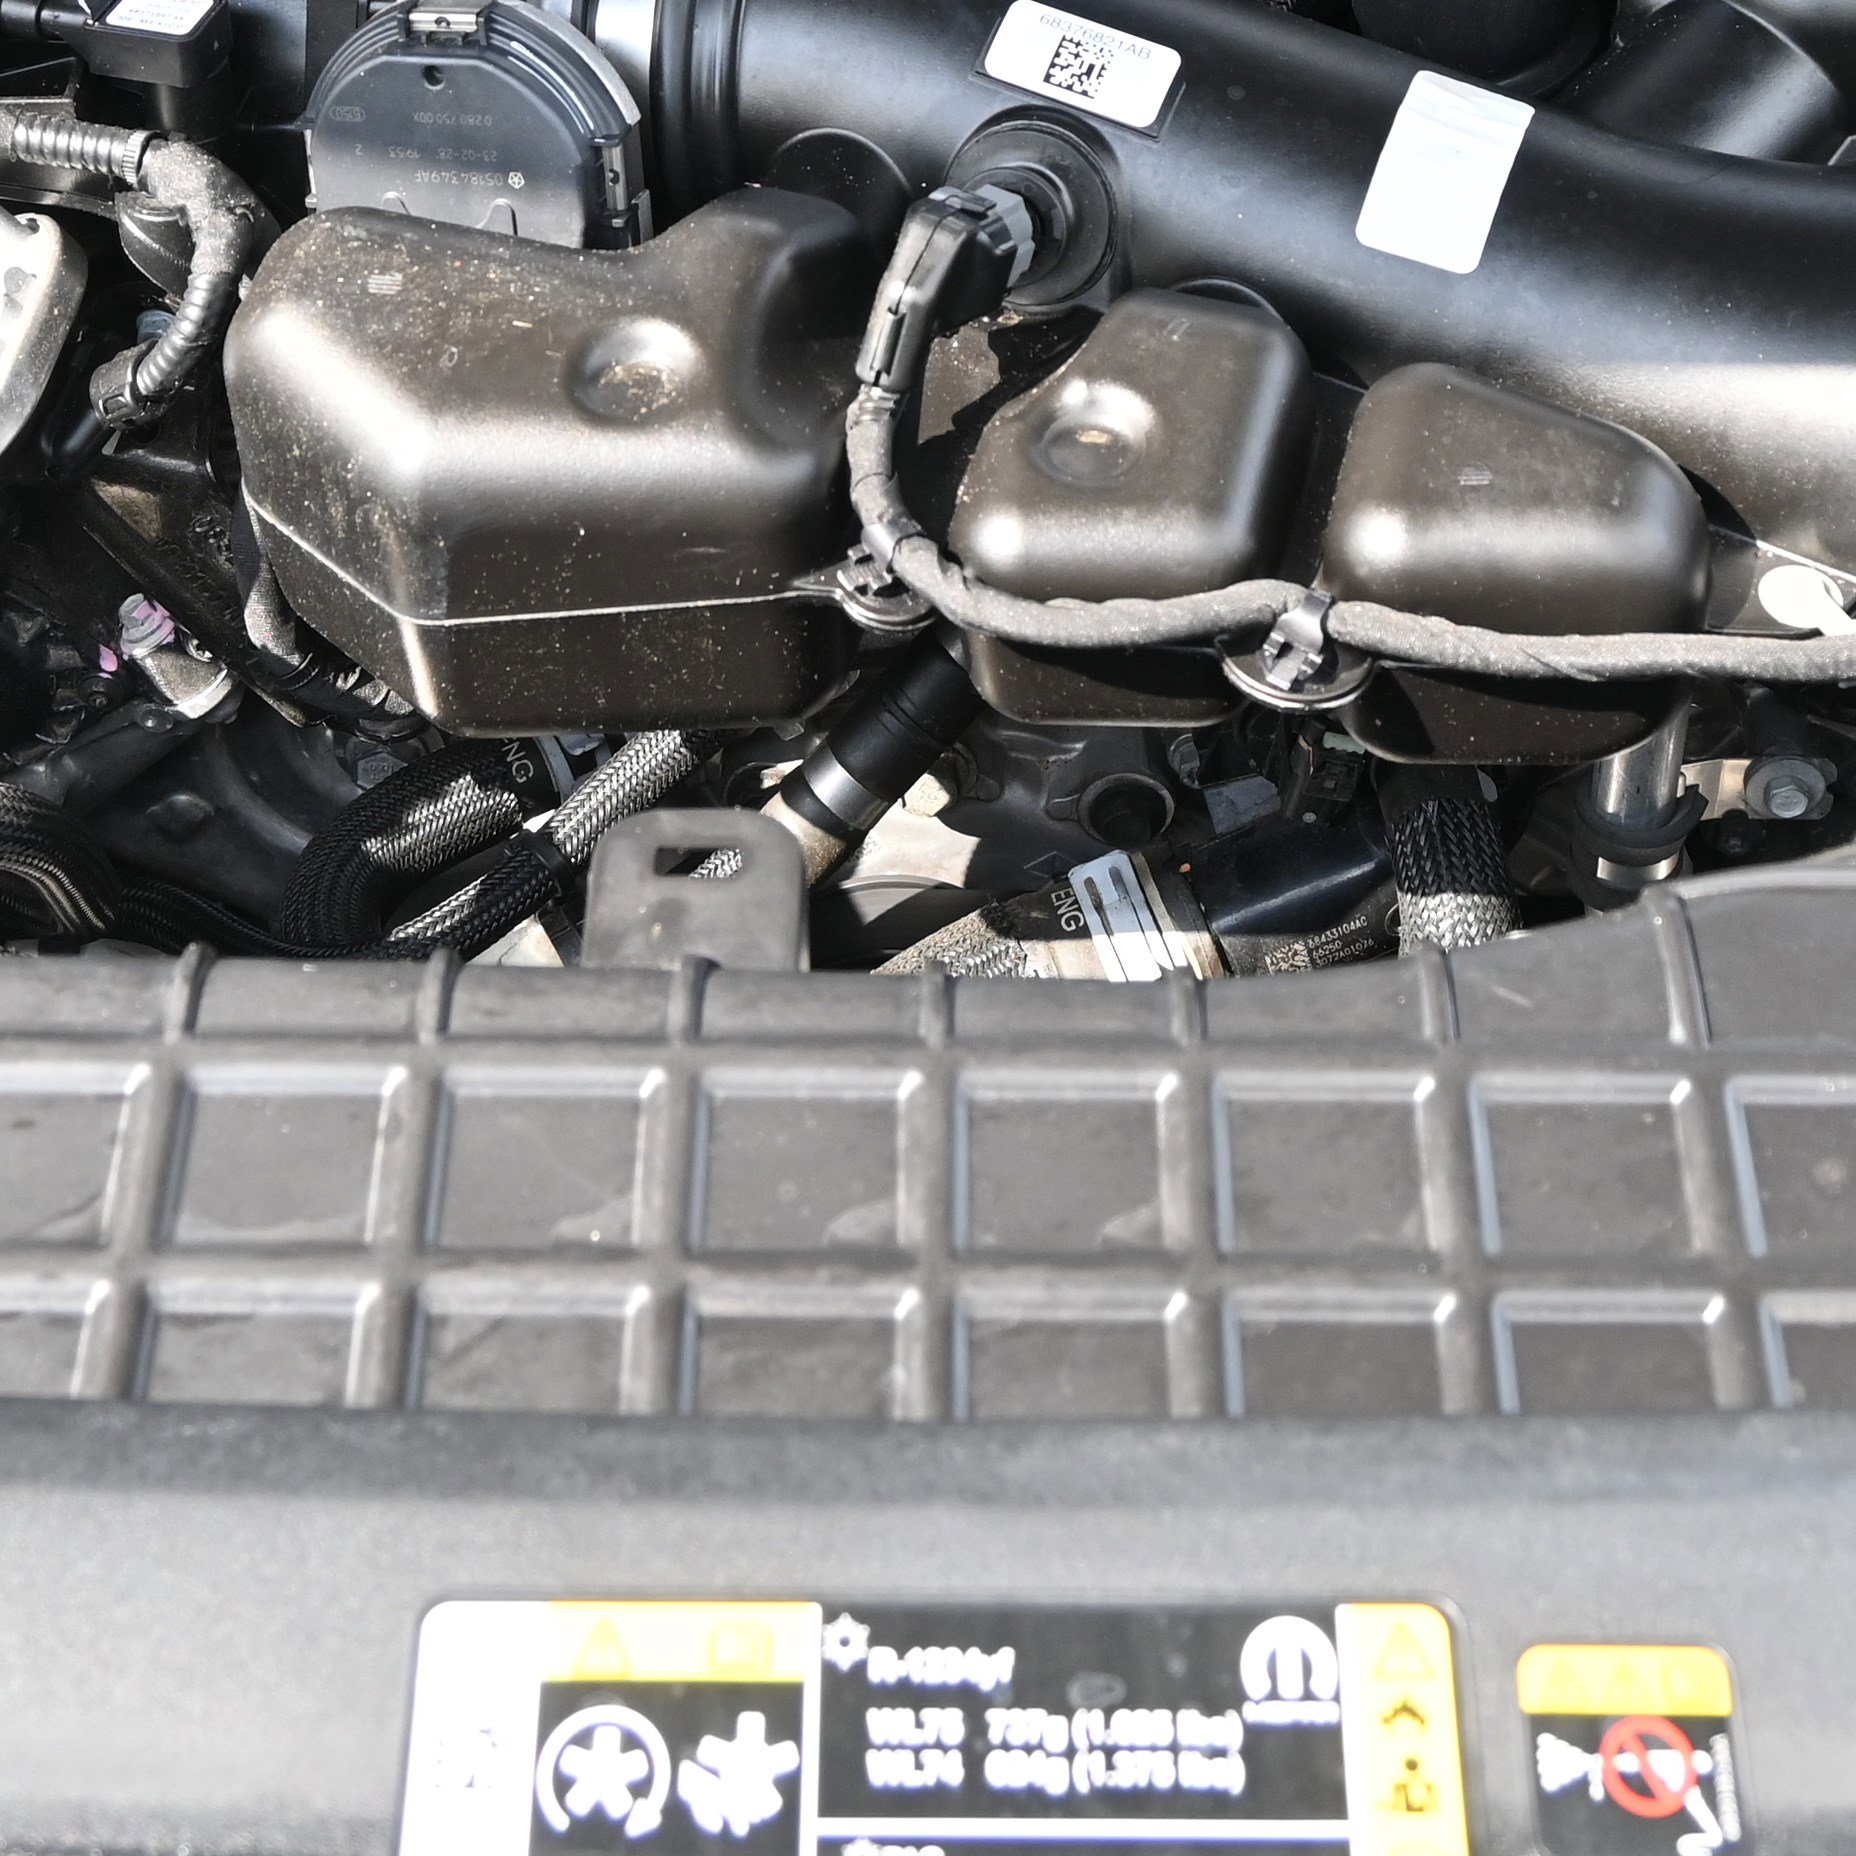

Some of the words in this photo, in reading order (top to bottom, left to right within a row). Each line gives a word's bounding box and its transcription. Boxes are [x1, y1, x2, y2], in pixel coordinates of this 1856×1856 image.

[1039, 13, 1152, 61] 68376821AB
[413, 170, 503, 187] 05184349AF
[500, 737, 535, 784] NG
[1050, 887, 1085, 933] ENG
